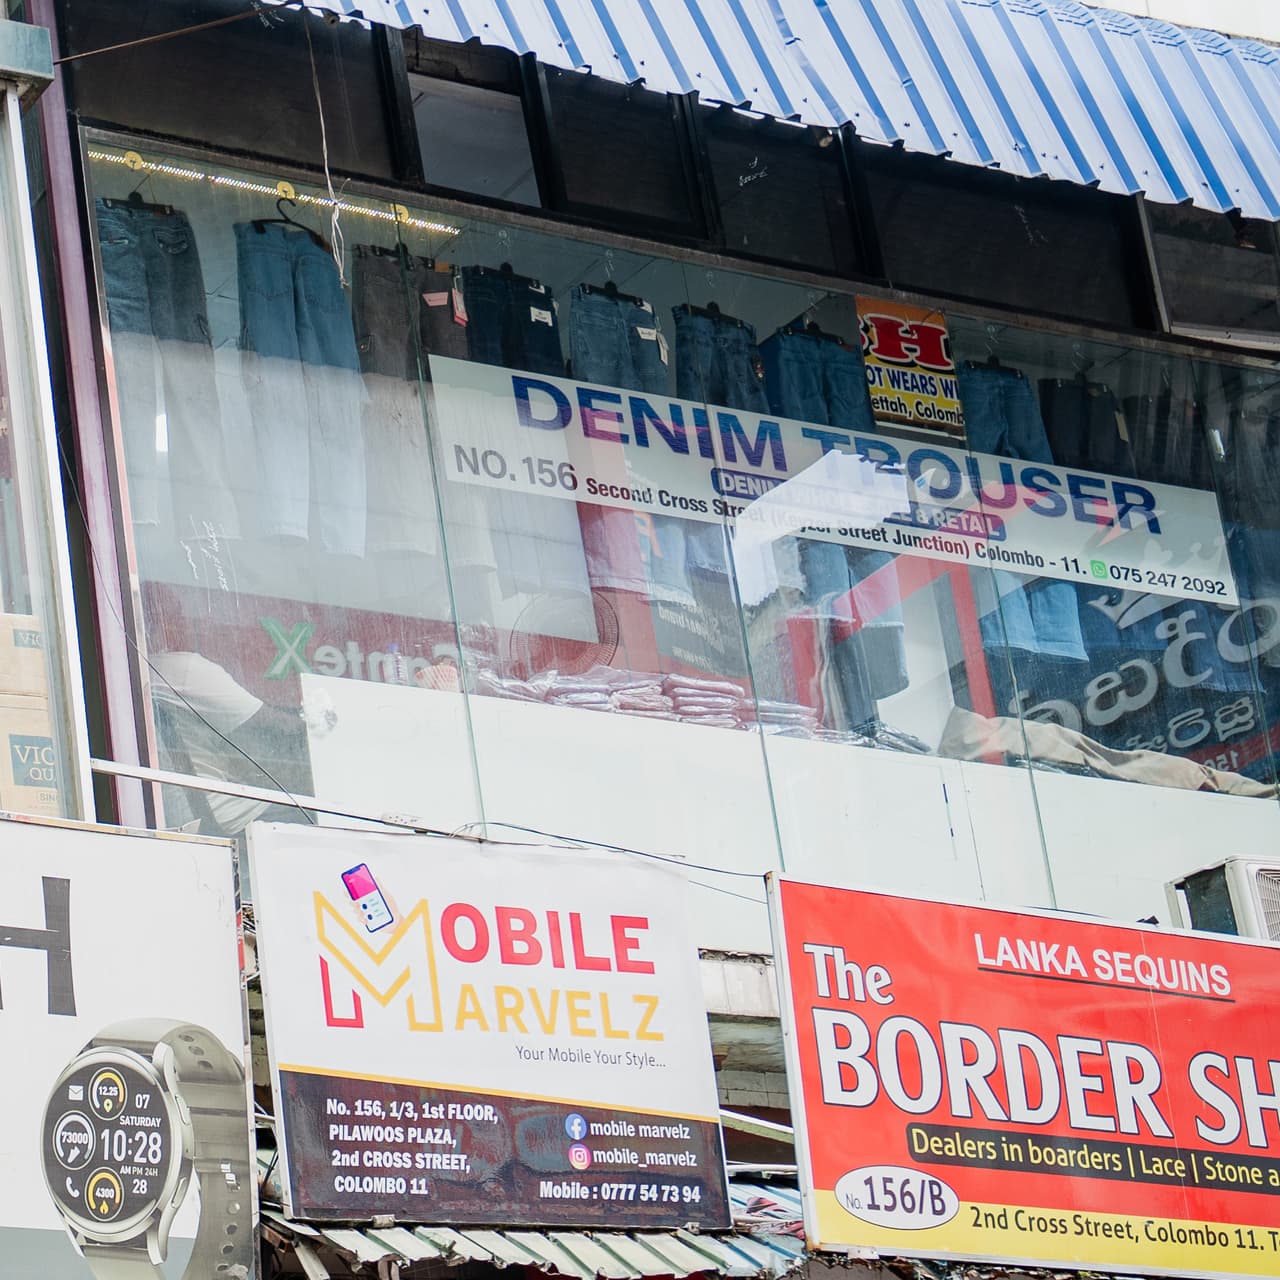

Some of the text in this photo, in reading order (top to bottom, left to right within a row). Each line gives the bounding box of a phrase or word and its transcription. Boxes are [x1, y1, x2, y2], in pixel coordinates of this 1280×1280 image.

[886, 369, 938, 398] WEARS
[512, 374, 788, 473] DENIM
[453, 443, 517, 482] NO.
[521, 455, 578, 492] 156
[586, 476, 653, 506] Second
[658, 489, 708, 515] Cross
[892, 527, 970, 559] Junction)
[975, 540, 1045, 569] Colombo
[1109, 564, 1142, 584] 075
[1146, 570, 1178, 590] 247
[1181, 575, 1228, 597] 2092
[803, 941, 895, 1006] The
[973, 932, 1232, 998] LANKA SEQUINS
[516, 1045, 545, 1063] Your
[548, 1046, 592, 1065] Mobile
[594, 1049, 623, 1067] Your
[811, 1006, 1175, 1140] BORDER
[135, 1094, 151, 1109] 07
[326, 1098, 499, 1126] No. 156, 1/3, 1st FLOOR,
[119, 1115, 162, 1128] SATURDAY
[590, 1120, 691, 1141] mobile marvelz
[61, 1131, 89, 1145] 73000
[100, 1128, 162, 1165] 10:28
[329, 1124, 457, 1149] PILAWOOS PLAZA,
[331, 1149, 471, 1175] 2nd CROSS STREET,
[593, 1147, 698, 1169] mobile_marvelz
[912, 1127, 1263, 1186] Dealers in boarders Lace Stone
[132, 1179, 148, 1194] 28
[334, 1175, 429, 1197] COLOMBO 11
[540, 1180, 702, 1204] Mobile 0777 54 73 94
[863, 1175, 948, 1217] 156/B
[972, 1204, 1265, 1251] 2nd Cross Street, Colombo 11.
